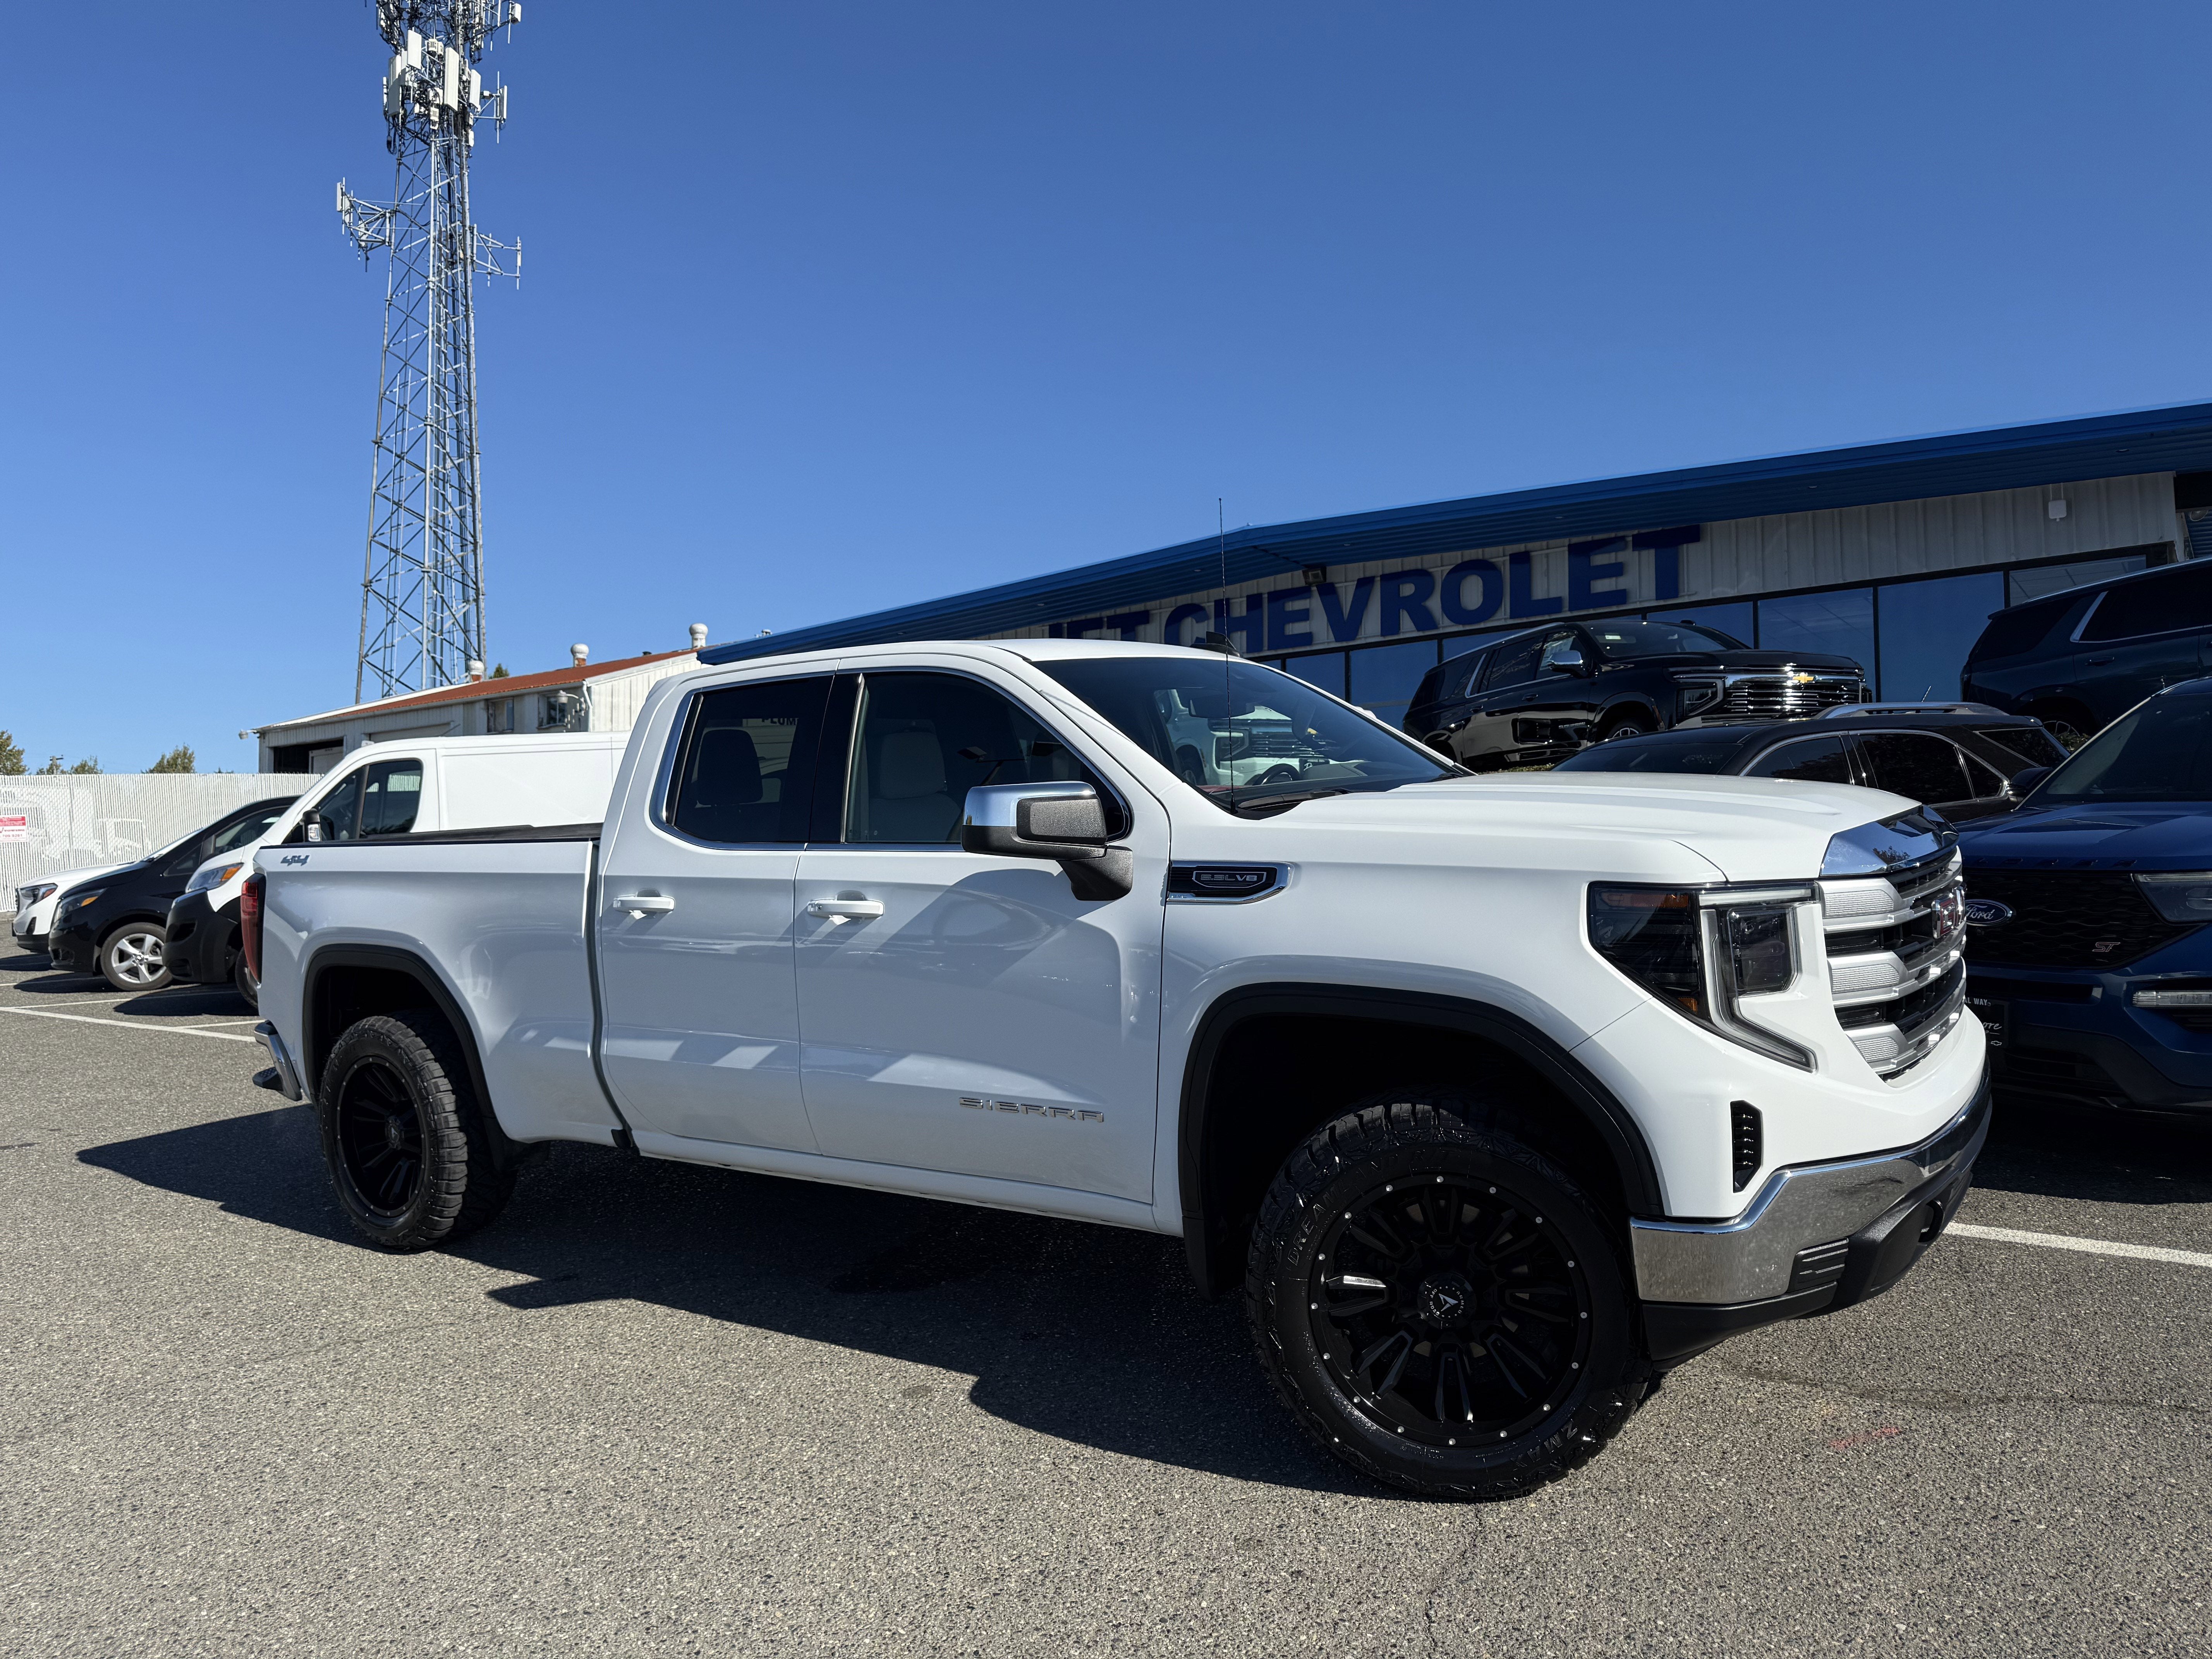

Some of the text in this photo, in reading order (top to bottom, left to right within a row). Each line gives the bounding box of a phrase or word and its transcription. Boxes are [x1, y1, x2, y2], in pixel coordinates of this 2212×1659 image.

[1164, 524, 1700, 653] CHEVROLET
[1965, 904, 1995, 920] Ford
[2092, 941, 2121, 952] ST
[1973, 998, 1988, 1006] WAY
[958, 1097, 1104, 1123] SIERRA
[1456, 1291, 1464, 1314] ARMED
